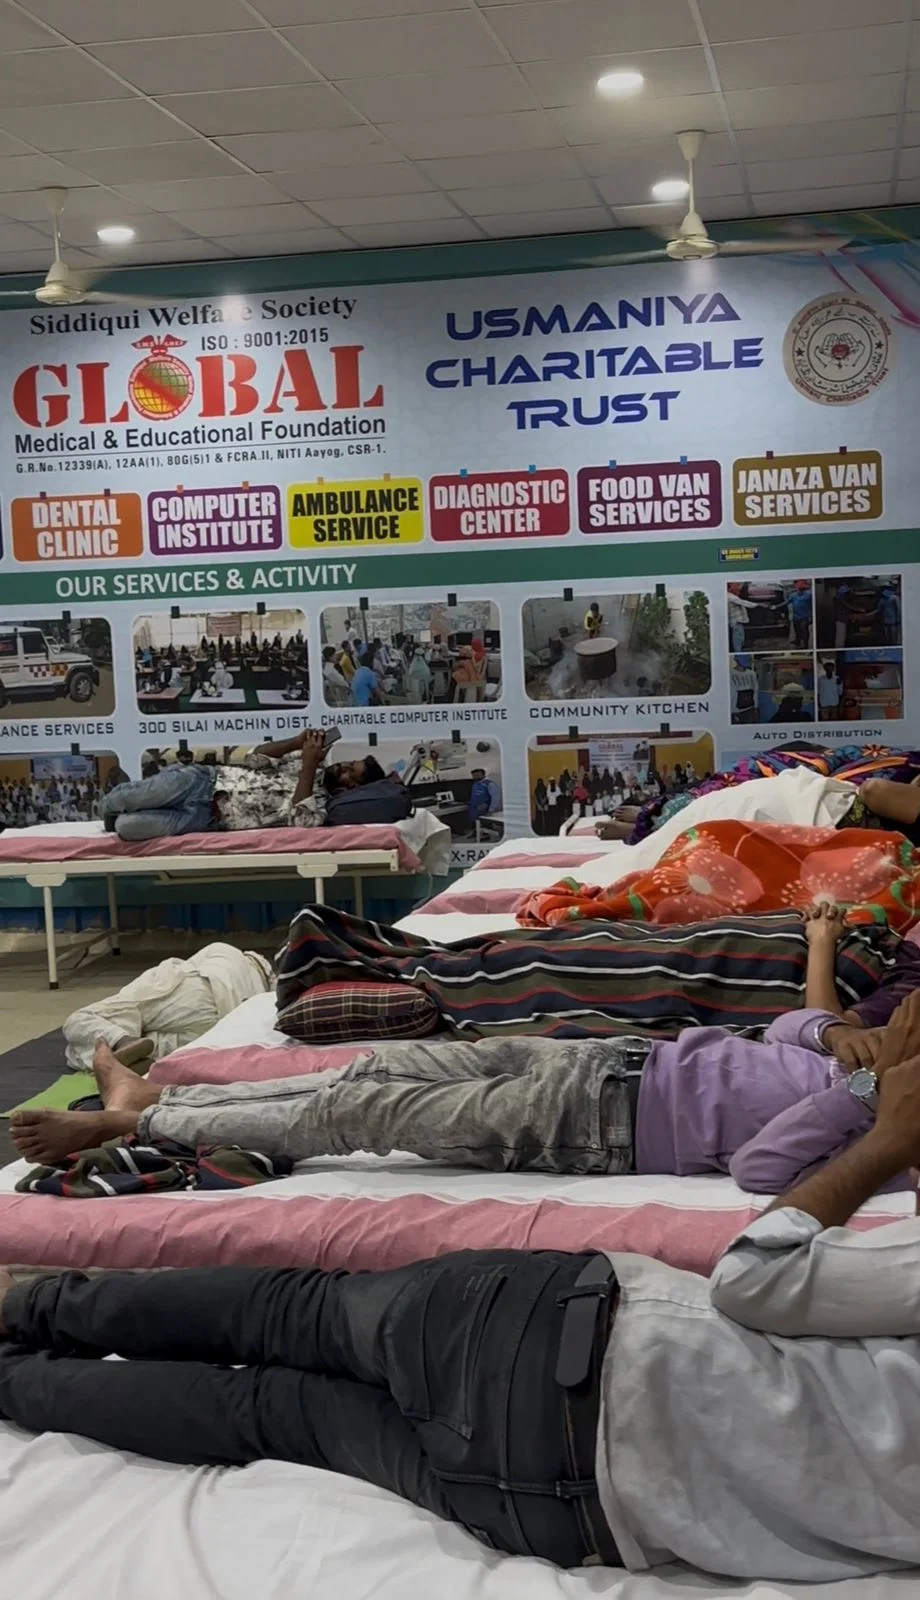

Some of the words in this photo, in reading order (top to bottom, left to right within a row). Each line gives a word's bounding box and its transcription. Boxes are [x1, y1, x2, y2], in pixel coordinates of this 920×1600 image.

[30, 309, 140, 336] Siddiqui
[148, 304, 252, 327] Welfae
[261, 296, 357, 320] Society
[446, 292, 741, 341] USMANIYA
[201, 335, 228, 351] ISO
[244, 327, 329, 348] 9001:2015
[425, 337, 764, 388] CHARITABLE
[12, 345, 384, 427] GLOBAL
[506, 390, 681, 430] TRUST
[15, 431, 95, 454] Medical
[103, 429, 118, 449] &
[126, 421, 253, 448] Educational
[261, 415, 386, 440] Foundation
[214, 453, 223, 464] &
[277, 448, 301, 460] NITI
[588, 476, 653, 501] FOOD
[659, 472, 710, 498] VAN
[736, 466, 822, 494] JANAZA
[828, 463, 877, 488] VAN
[151, 491, 277, 523] COMPUTER
[292, 487, 419, 517] AMBULANCE
[433, 479, 566, 510] DIAGNOSTIC
[744, 489, 871, 519] SERVICES
[31, 498, 122, 529] DENTAL
[460, 507, 540, 536] CENTER
[589, 498, 711, 527] SERVICES
[36, 528, 120, 559] CLINIC
[157, 519, 274, 549] INSTITUTE
[313, 515, 400, 543] SERVICE
[55, 576, 107, 597] OUR
[113, 570, 219, 595] SERVICES
[226, 568, 245, 590] &
[252, 563, 357, 589] ACTIVITY
[139, 721, 166, 734] 300
[172, 719, 208, 733] SILAI
[215, 717, 270, 731] MACHIN
[276, 715, 312, 730] DIST.
[321, 713, 386, 726] CHARITABLE
[390, 710, 449, 723] COMPUTER
[452, 708, 507, 721] INSTITUTE
[530, 704, 630, 719] COMMUNITY
[636, 701, 710, 715] KITCHEN
[44, 722, 114, 736] SERVICES
[451, 850, 490, 862] X-RA
